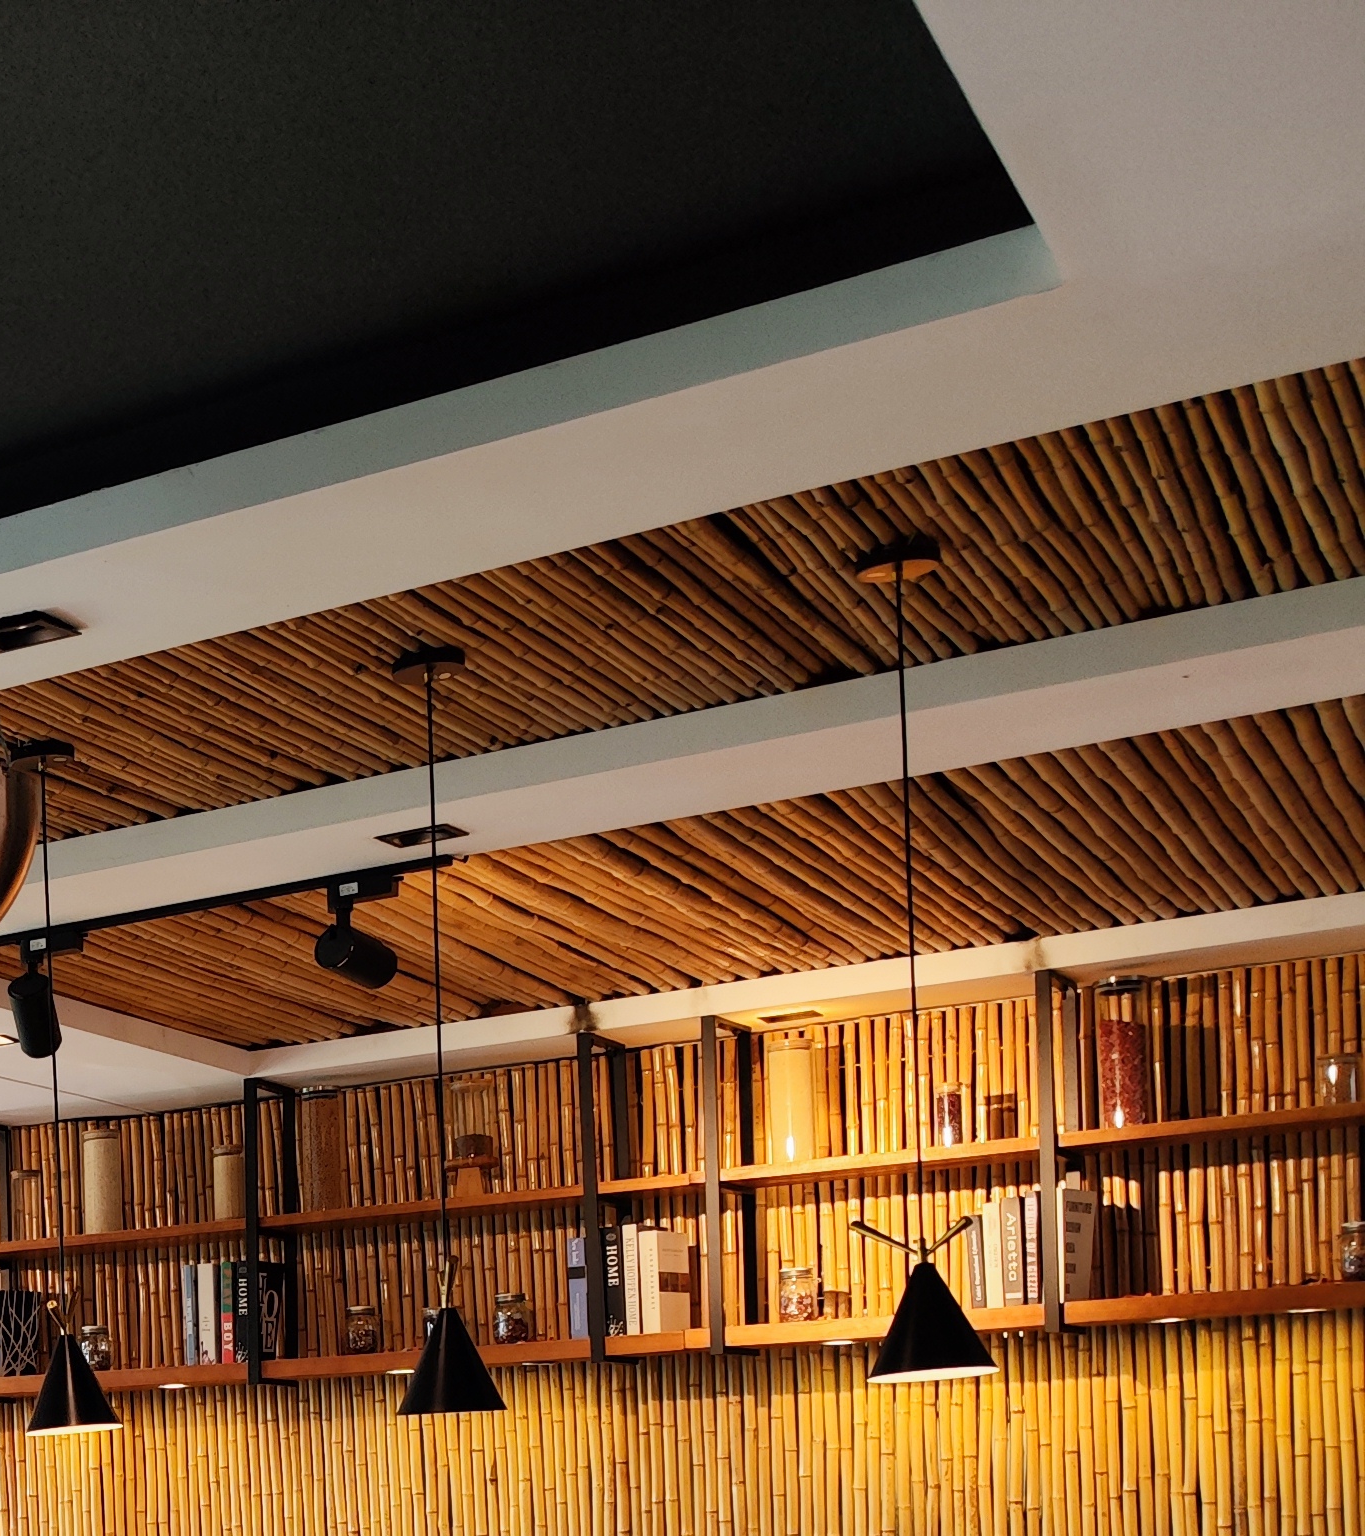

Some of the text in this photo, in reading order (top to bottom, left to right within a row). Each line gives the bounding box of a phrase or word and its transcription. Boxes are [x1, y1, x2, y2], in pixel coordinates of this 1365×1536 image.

[605, 1244, 620, 1287] HOME
[625, 1237, 638, 1327] KELLY HOPPEN HOME
[238, 1278, 248, 1316] HOME
[223, 1321, 233, 1351] BOY
